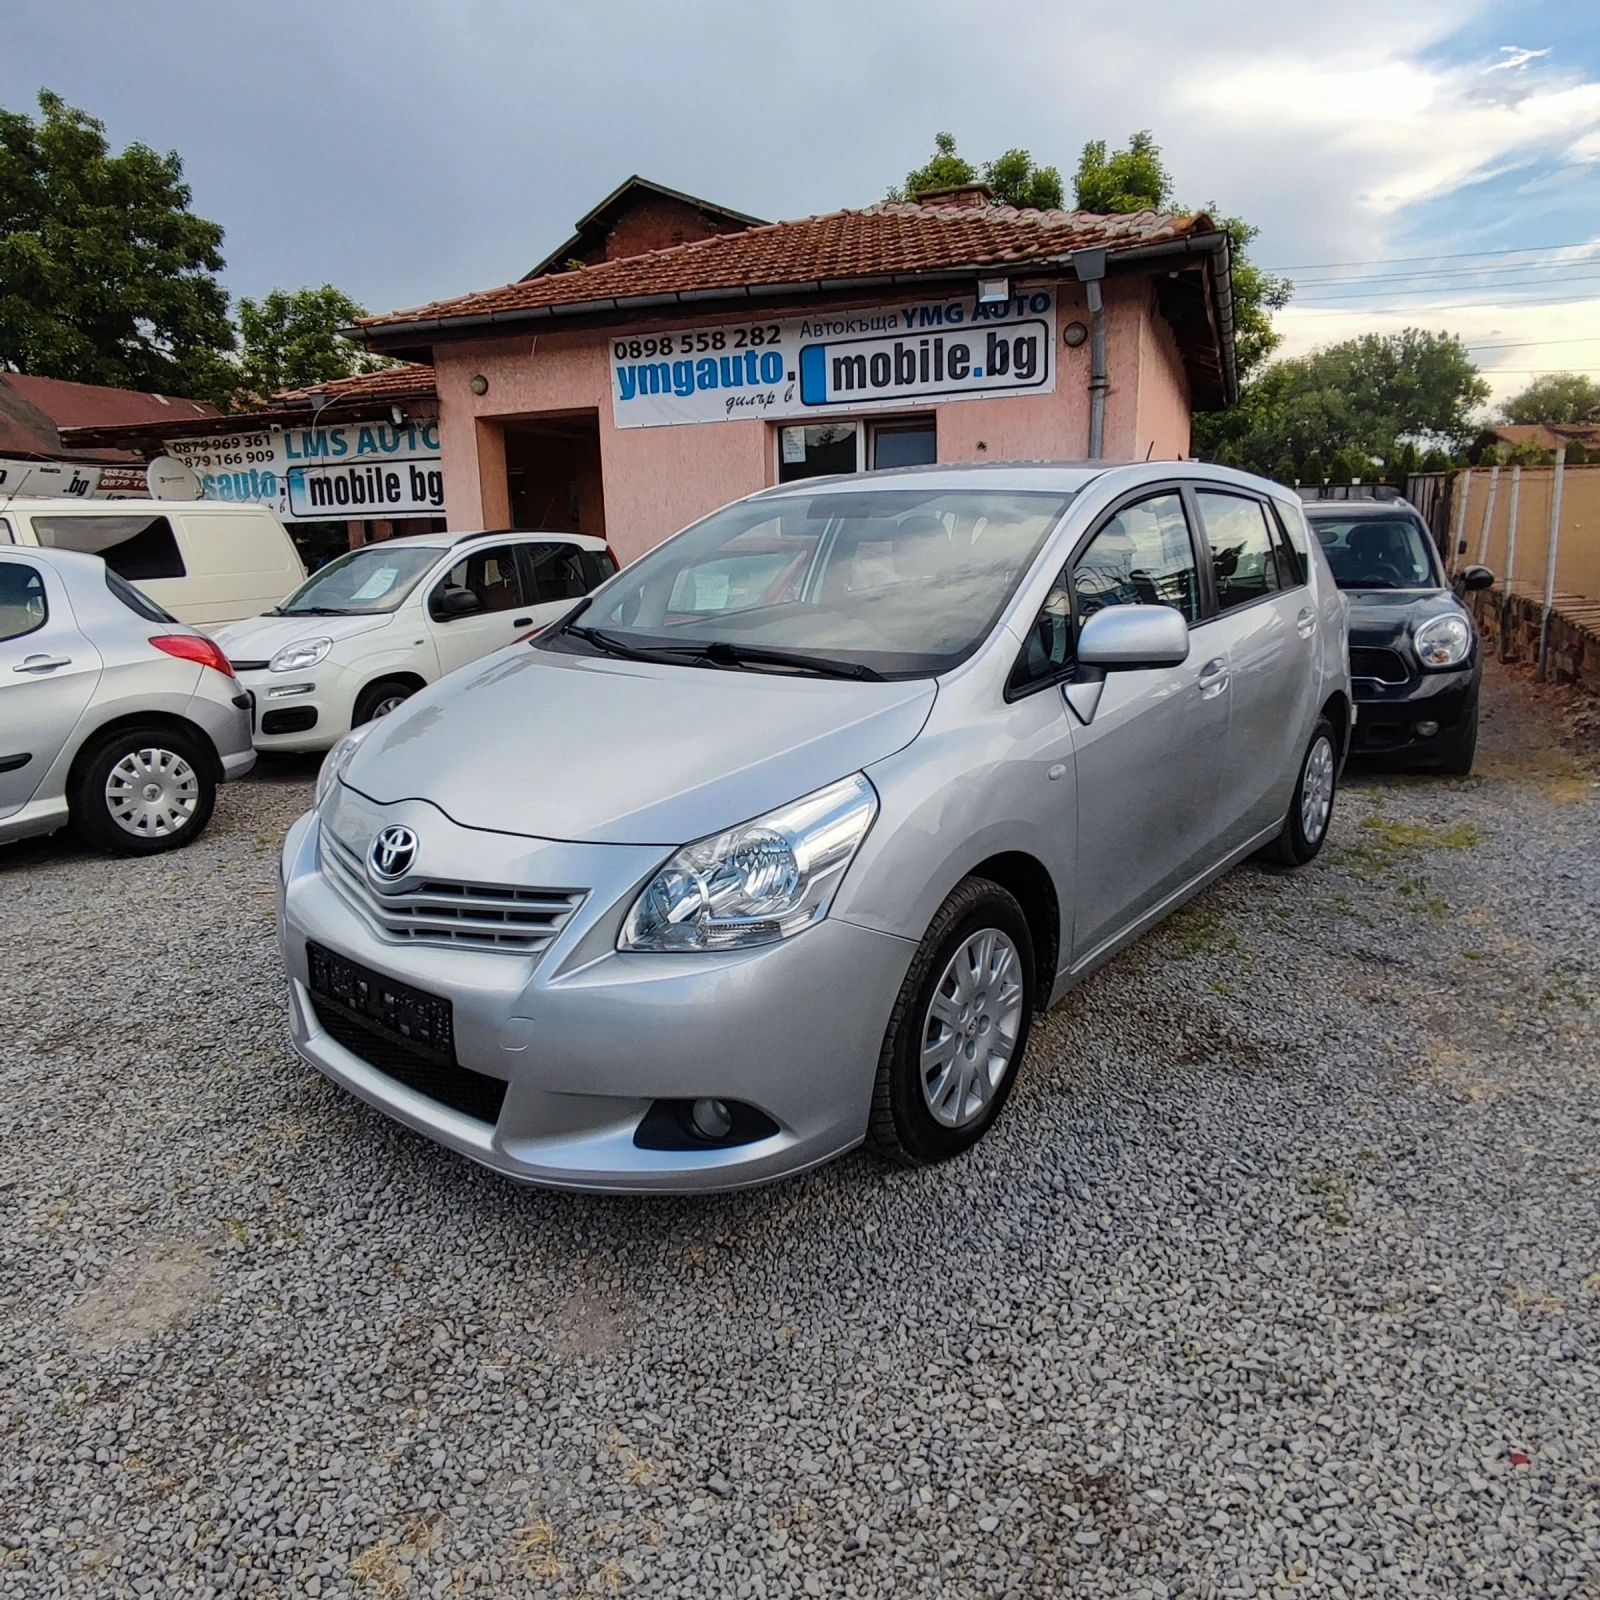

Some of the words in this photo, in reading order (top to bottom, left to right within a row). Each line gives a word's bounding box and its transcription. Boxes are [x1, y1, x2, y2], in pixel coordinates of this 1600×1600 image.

[800, 314, 898, 339] Автокъща
[901, 302, 964, 329] YMG
[971, 292, 1051, 322] AUTO
[614, 337, 674, 360] 0898
[680, 331, 726, 354] 558
[733, 324, 782, 349] 282
[832, 332, 1037, 391] mobile.bg
[173, 440, 209, 454] 0879
[212, 437, 240, 450] 969
[244, 434, 271, 448] 361
[179, 455, 211, 468] 879
[215, 453, 243, 466] 166
[246, 449, 275, 463] 909
[284, 429, 348, 460] LMS
[101, 479, 130, 487] 0879
